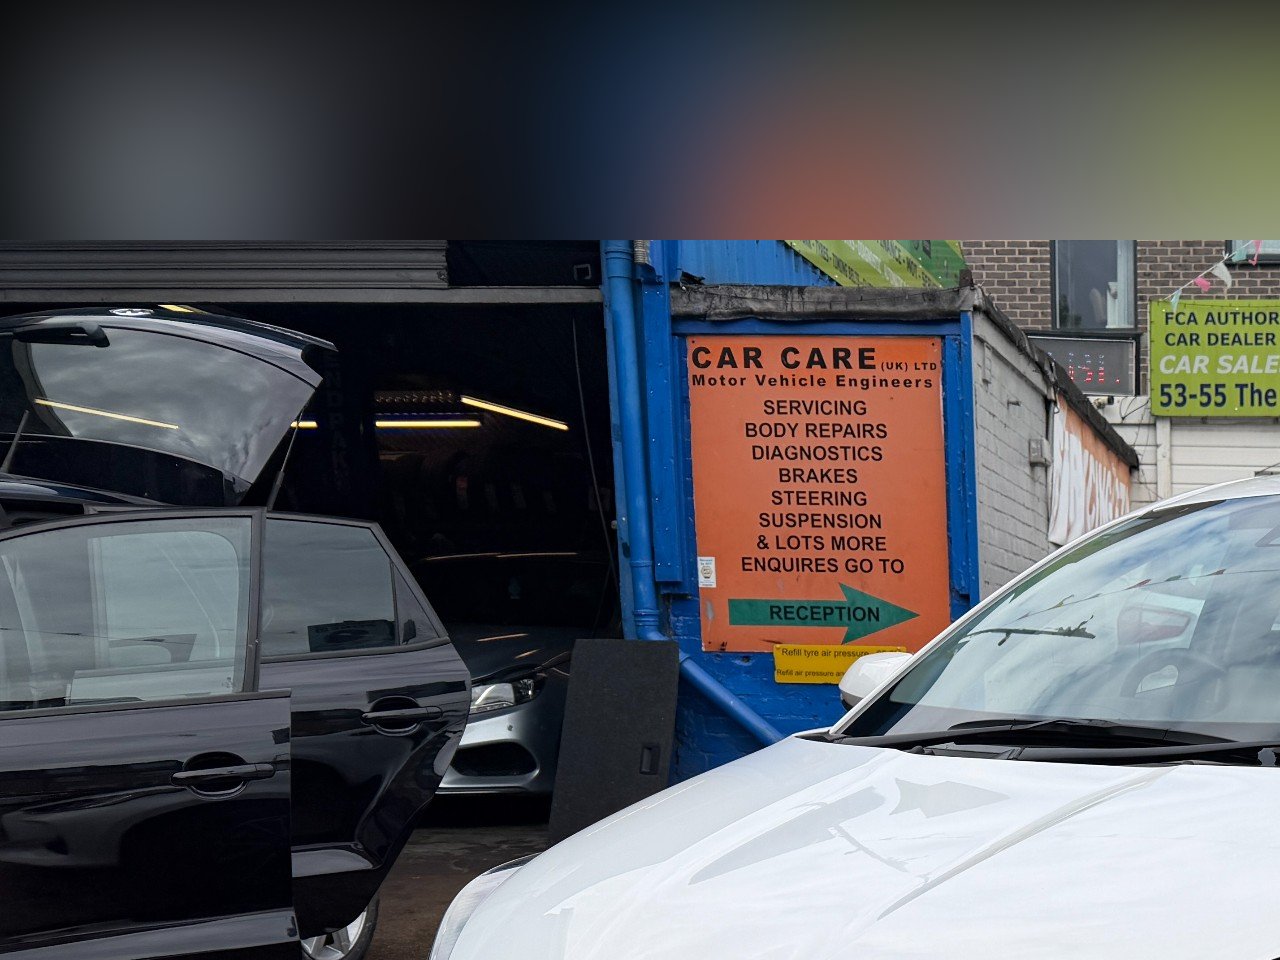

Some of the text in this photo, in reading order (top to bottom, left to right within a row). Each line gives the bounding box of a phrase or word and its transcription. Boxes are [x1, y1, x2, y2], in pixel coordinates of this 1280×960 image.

[1165, 312, 1198, 326] FCA
[1164, 333, 1276, 346] CAR DEALER
[692, 346, 938, 372] CAR CARE (UK) LTD
[1159, 355, 1209, 374] CAR
[692, 374, 933, 390] Motor Vehicle Engineers
[1159, 383, 1227, 408] 53-55
[1235, 383, 1277, 408] The
[763, 400, 867, 415] SERVICING
[745, 423, 888, 439] BODY REPAIRS
[751, 445, 883, 461] DIAGNOSTICS
[778, 468, 858, 483] BRAKES
[771, 490, 867, 506] STEERING
[759, 512, 882, 529] SUSPENSION
[756, 535, 887, 551] & LOTS MORE
[741, 557, 905, 574] ENQUIRES GO TO
[769, 605, 880, 621] RECEPTION
[781, 648, 802, 656] Refill
[804, 649, 819, 658] tyre
[834, 650, 869, 659] pressure
[776, 668, 793, 676] Refill
[804, 670, 834, 678] pressure
